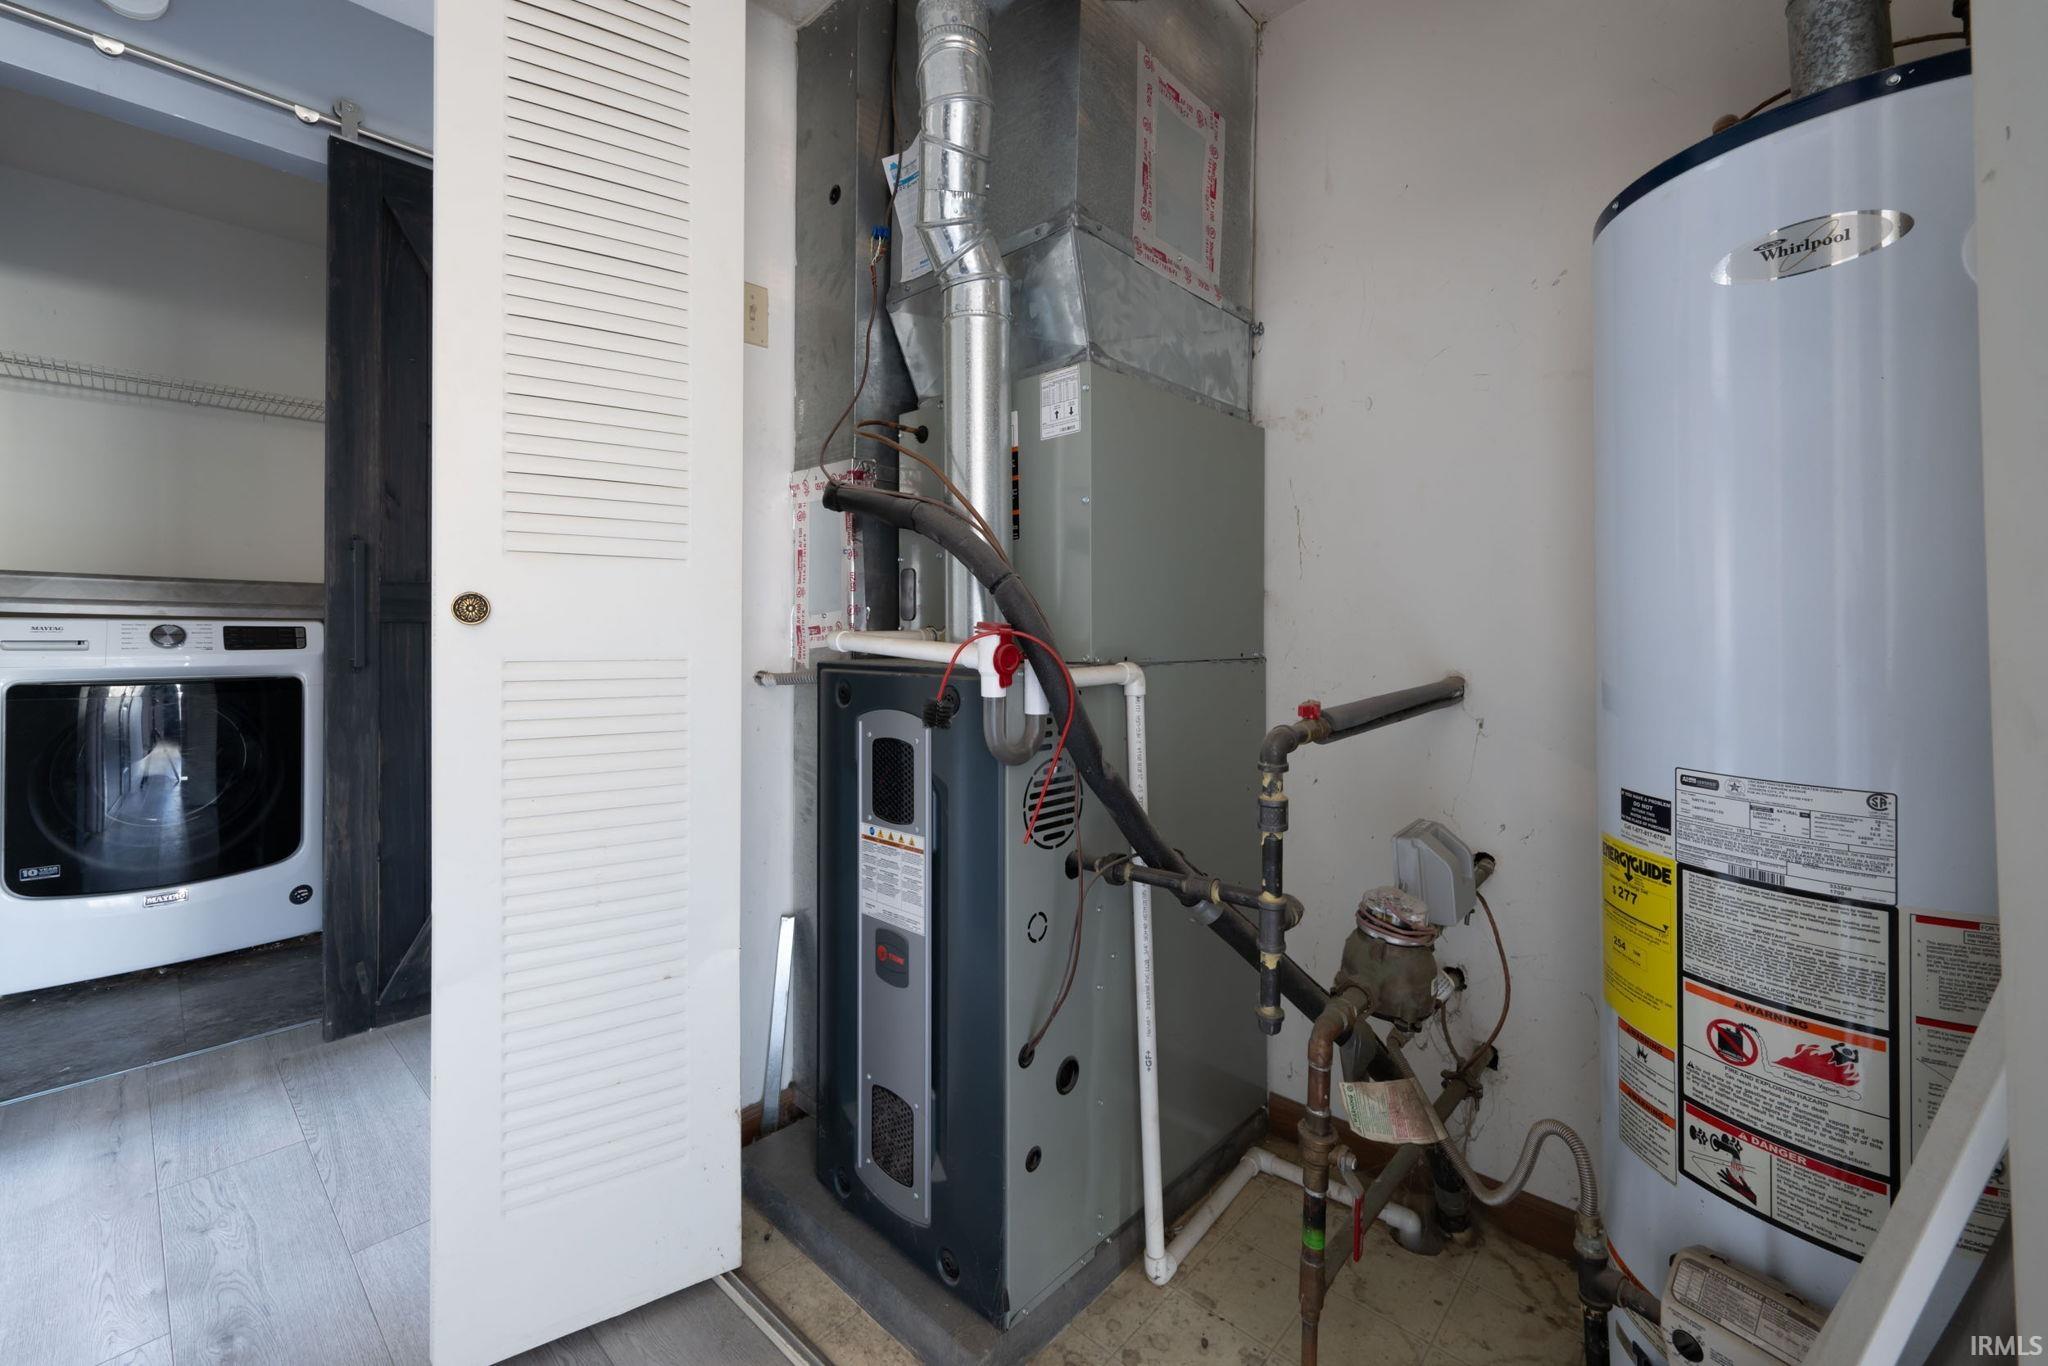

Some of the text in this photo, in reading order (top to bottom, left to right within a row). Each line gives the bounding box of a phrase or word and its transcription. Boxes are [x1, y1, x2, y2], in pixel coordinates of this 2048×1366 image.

[1760, 228, 1850, 262] Whirlpool
[1642, 803, 1653, 811] NOT
[146, 891, 186, 905] MAYTAG
[1618, 886, 1638, 904] 277
[1614, 936, 1626, 950] 254
[1753, 929, 1787, 941] IMPORTANT
[1730, 975, 1745, 984] STATE
[1759, 984, 1795, 999] CALIFORNIA
[1798, 995, 1822, 1005] NOTICE
[1741, 1002, 1808, 1030] WARNING
[1725, 1066, 1828, 1108] FIRE AND EXPLOSION HAZARD
[1784, 1072, 1840, 1096] Flammable Vapors
[1750, 1138, 1807, 1166] DANGER
[1738, 1281, 1763, 1301] LIGHT
[1766, 1298, 1788, 1314] CODE
